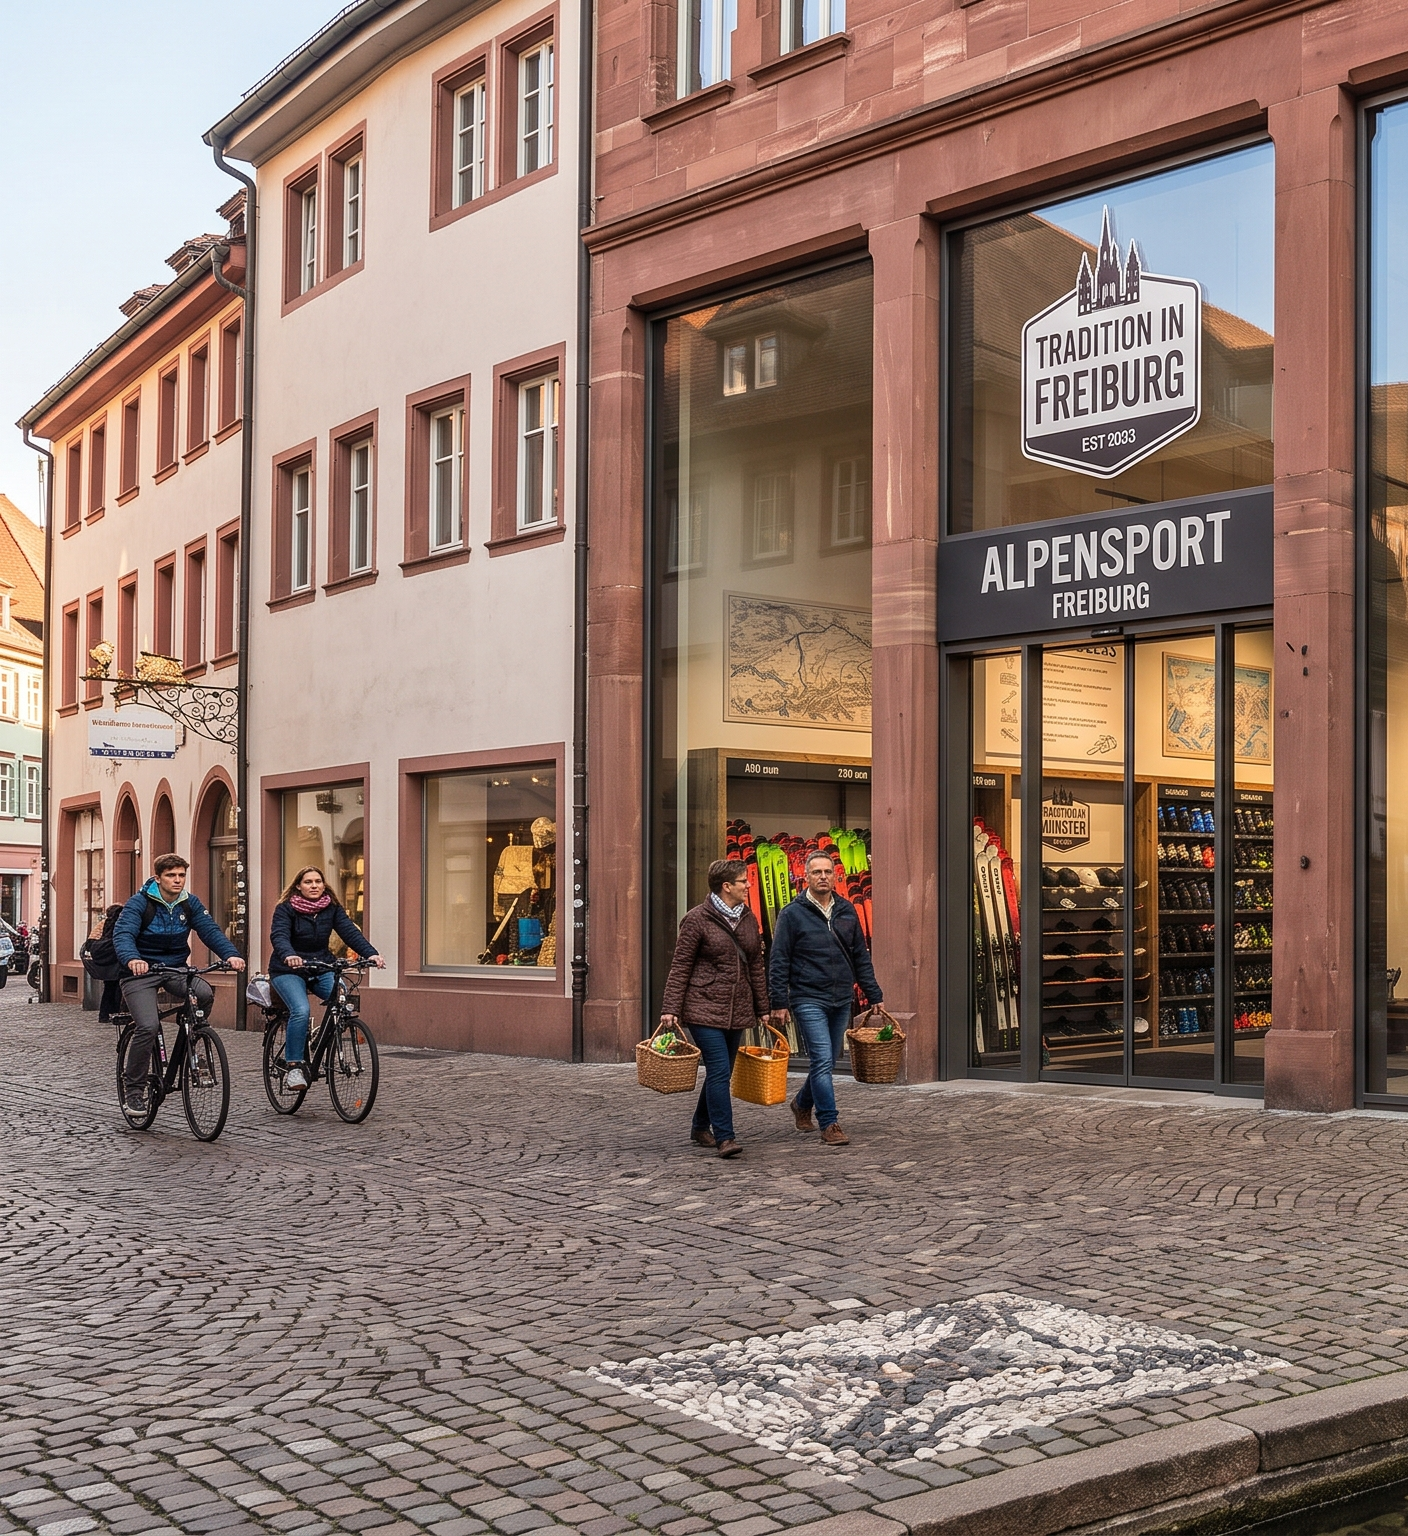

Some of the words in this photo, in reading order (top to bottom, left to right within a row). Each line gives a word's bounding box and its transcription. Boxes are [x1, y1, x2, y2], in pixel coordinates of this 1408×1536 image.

[1036, 311, 1152, 369] TRADITION
[1161, 303, 1184, 342] IN
[1036, 349, 1184, 425] FREIBURG
[1082, 434, 1106, 452] EST
[1107, 428, 1136, 447] 2033
[980, 510, 1231, 594] ALPENSPORT
[1053, 581, 1150, 619] FREIBURG
